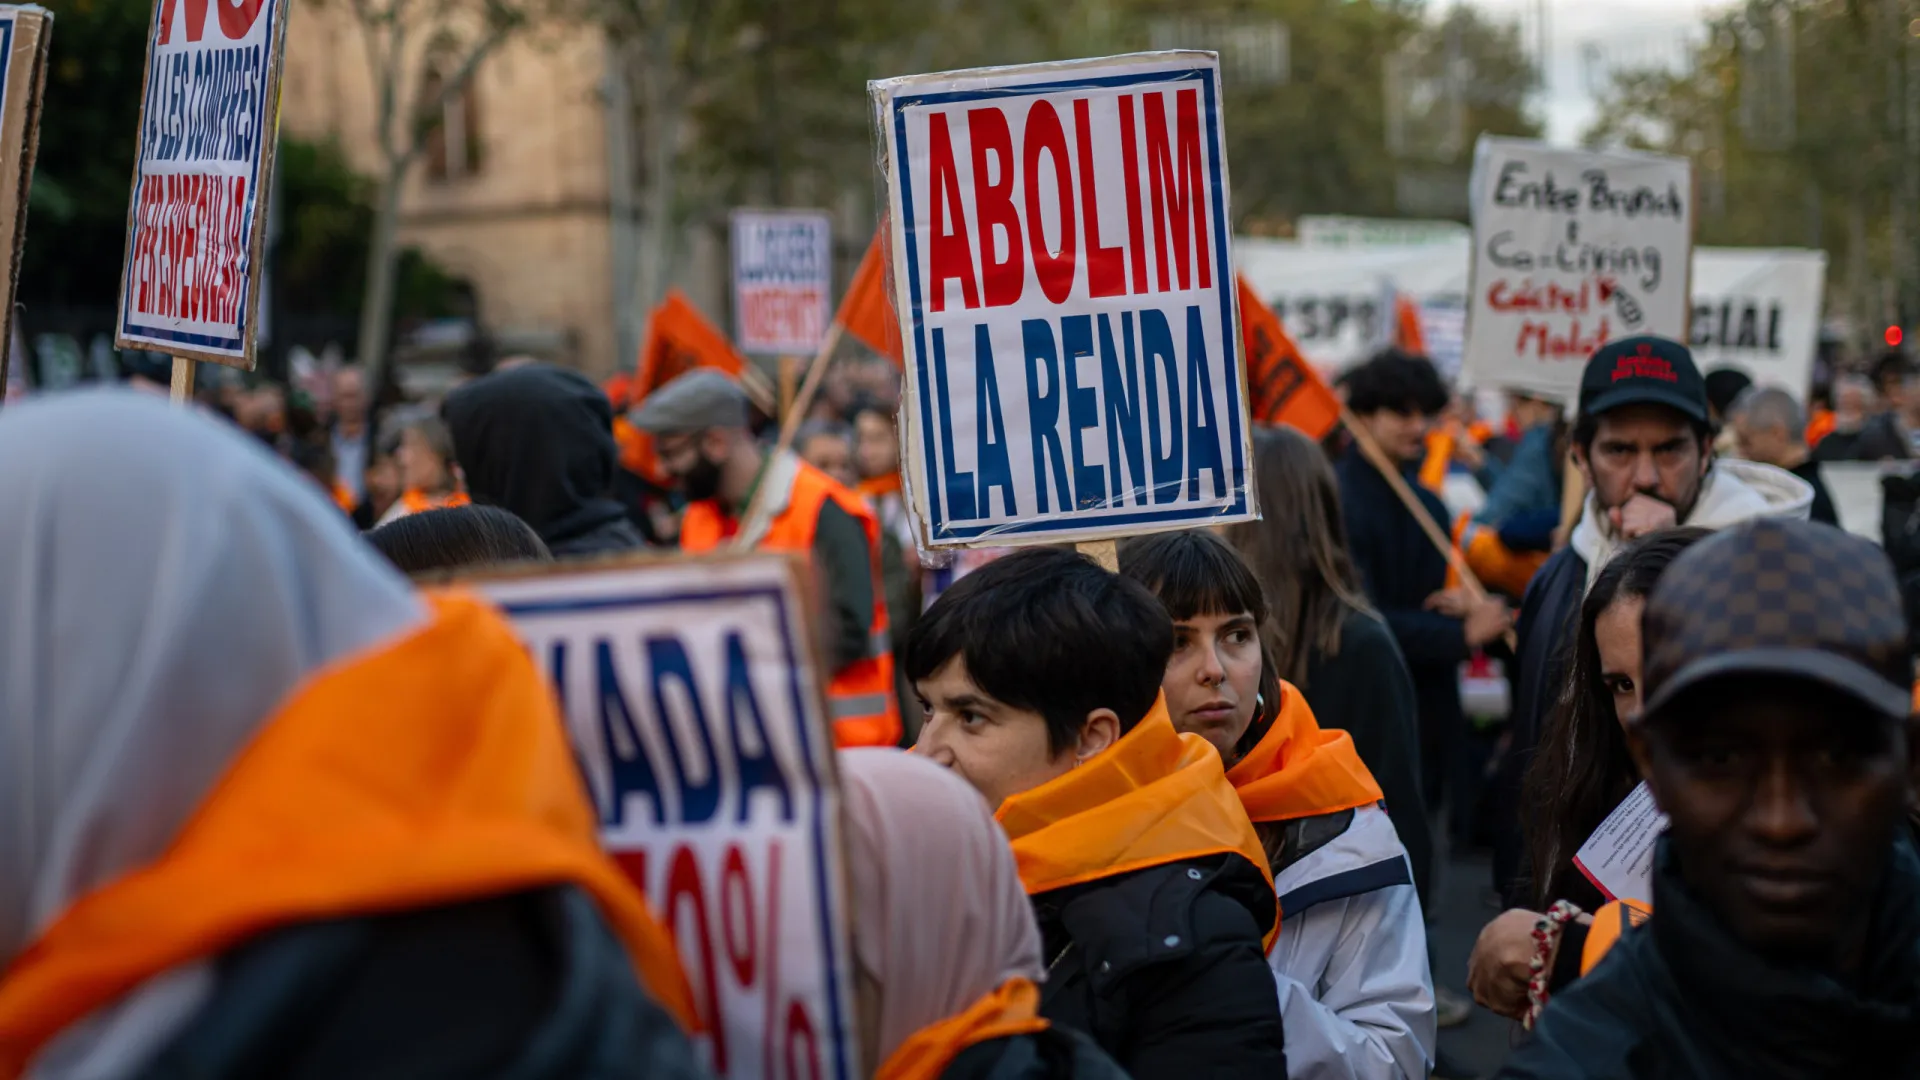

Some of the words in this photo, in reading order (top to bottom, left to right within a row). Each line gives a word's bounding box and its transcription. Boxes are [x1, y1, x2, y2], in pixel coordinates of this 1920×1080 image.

[145, 55, 161, 161] A
[157, 51, 190, 162] LES
[185, 44, 260, 163] COMPRES
[130, 174, 164, 315] PER
[158, 172, 246, 325] ESPECULAR
[929, 89, 1212, 313] ABOLIM
[1487, 229, 1662, 293] Co-Living
[931, 323, 1017, 520] LA
[1021, 305, 1226, 515] RENDA
[610, 841, 822, 1080] 0%
